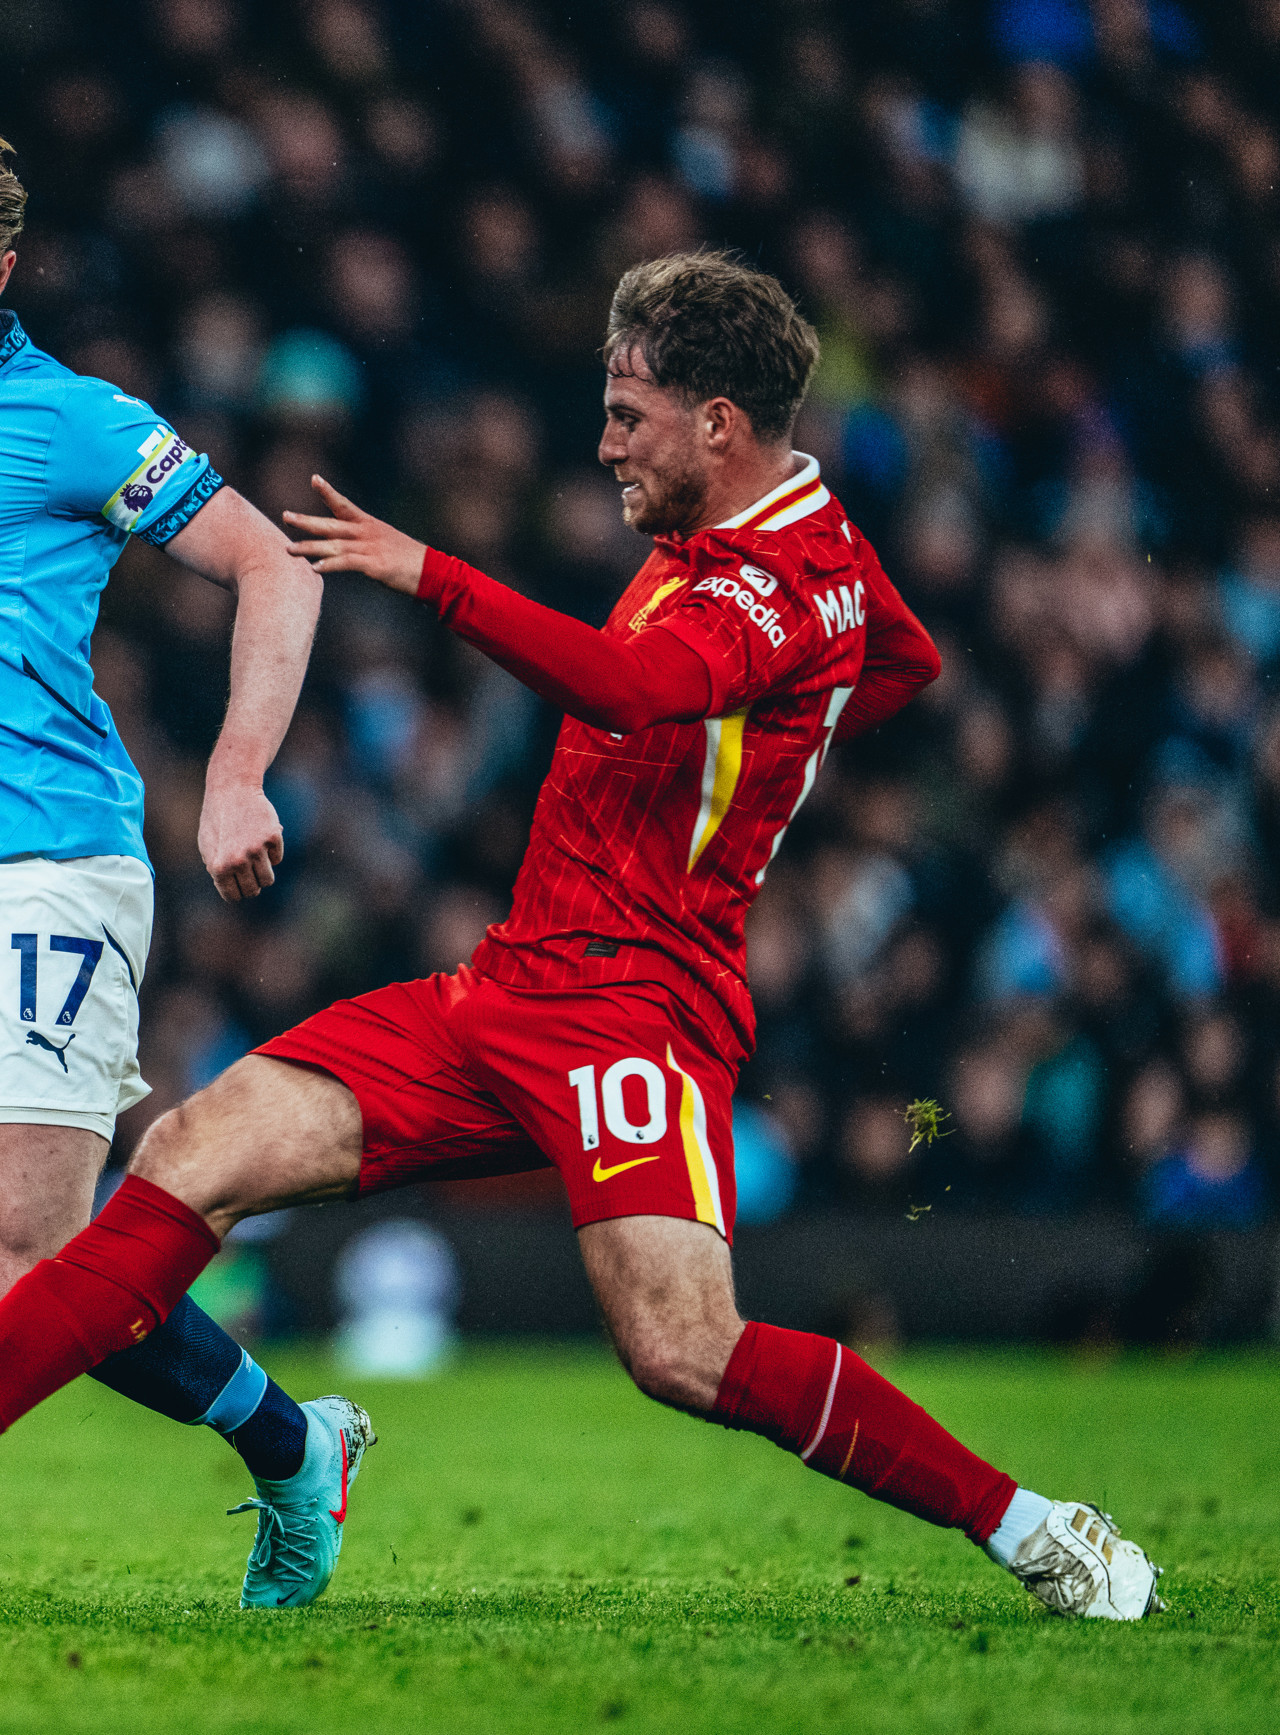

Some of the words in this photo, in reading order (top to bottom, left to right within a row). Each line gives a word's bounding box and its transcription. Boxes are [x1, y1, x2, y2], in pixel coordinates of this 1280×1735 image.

[146, 437, 189, 484] Capt
[692, 576, 786, 648] expedia
[813, 580, 865, 638] MAC
[11, 933, 104, 1026] 17
[568, 1057, 667, 1151] 10
